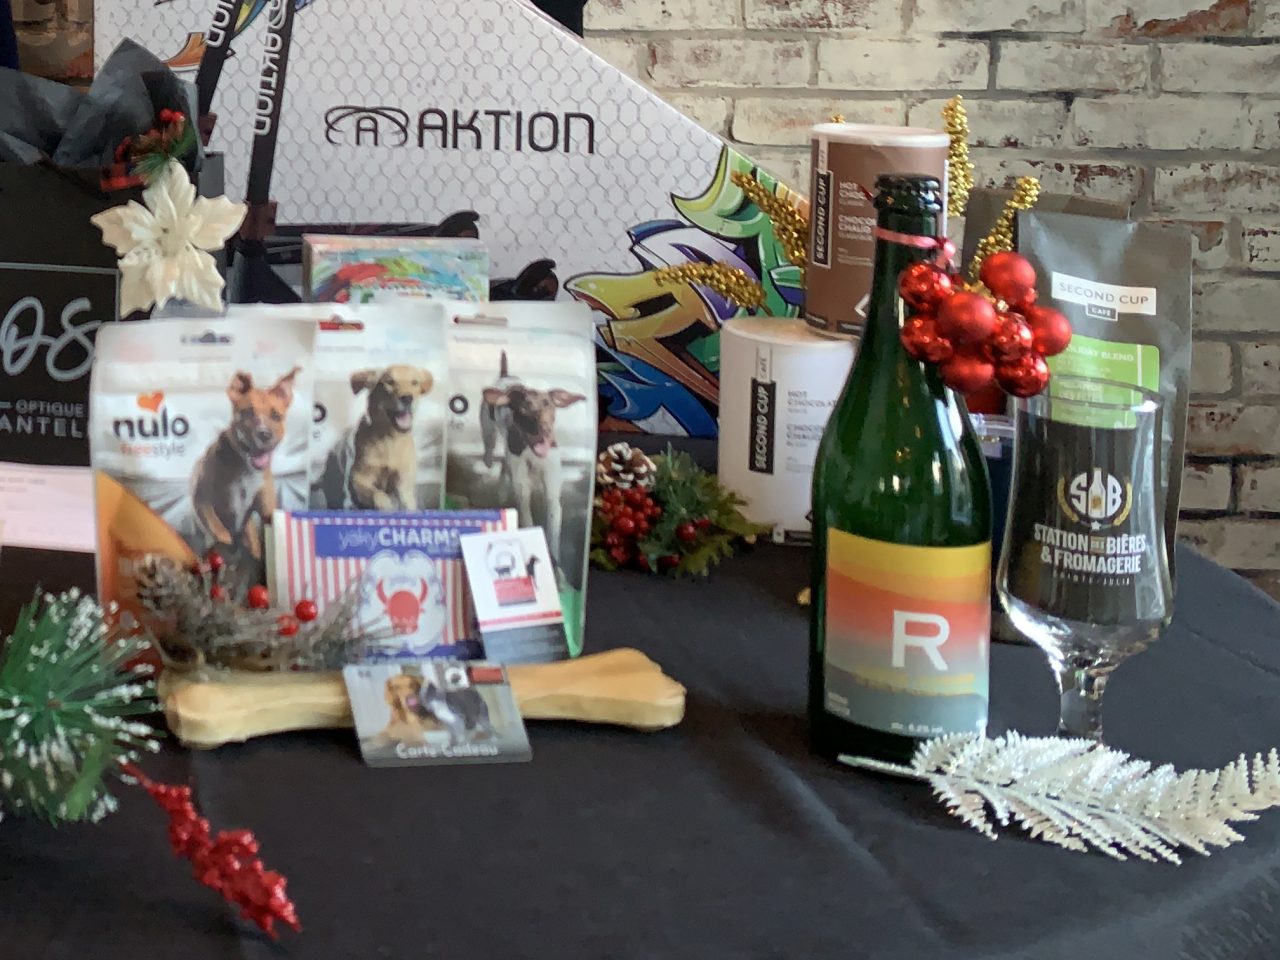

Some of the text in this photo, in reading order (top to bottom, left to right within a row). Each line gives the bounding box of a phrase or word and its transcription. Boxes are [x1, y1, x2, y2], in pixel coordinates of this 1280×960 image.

[253, 32, 283, 136] AKTION
[417, 108, 595, 155] AKTION
[816, 178, 827, 260] SECOND CUP
[1058, 282, 1149, 305] SECOND CUP
[16, 399, 84, 417] OPTIQUE
[113, 407, 190, 439] nulo
[755, 386, 770, 470] SECOND CUP
[1034, 523, 1088, 552] STATION
[1040, 545, 1141, 574] & FROMAGERIE
[892, 610, 950, 671] R
[396, 737, 498, 759] Carte Cadeau
